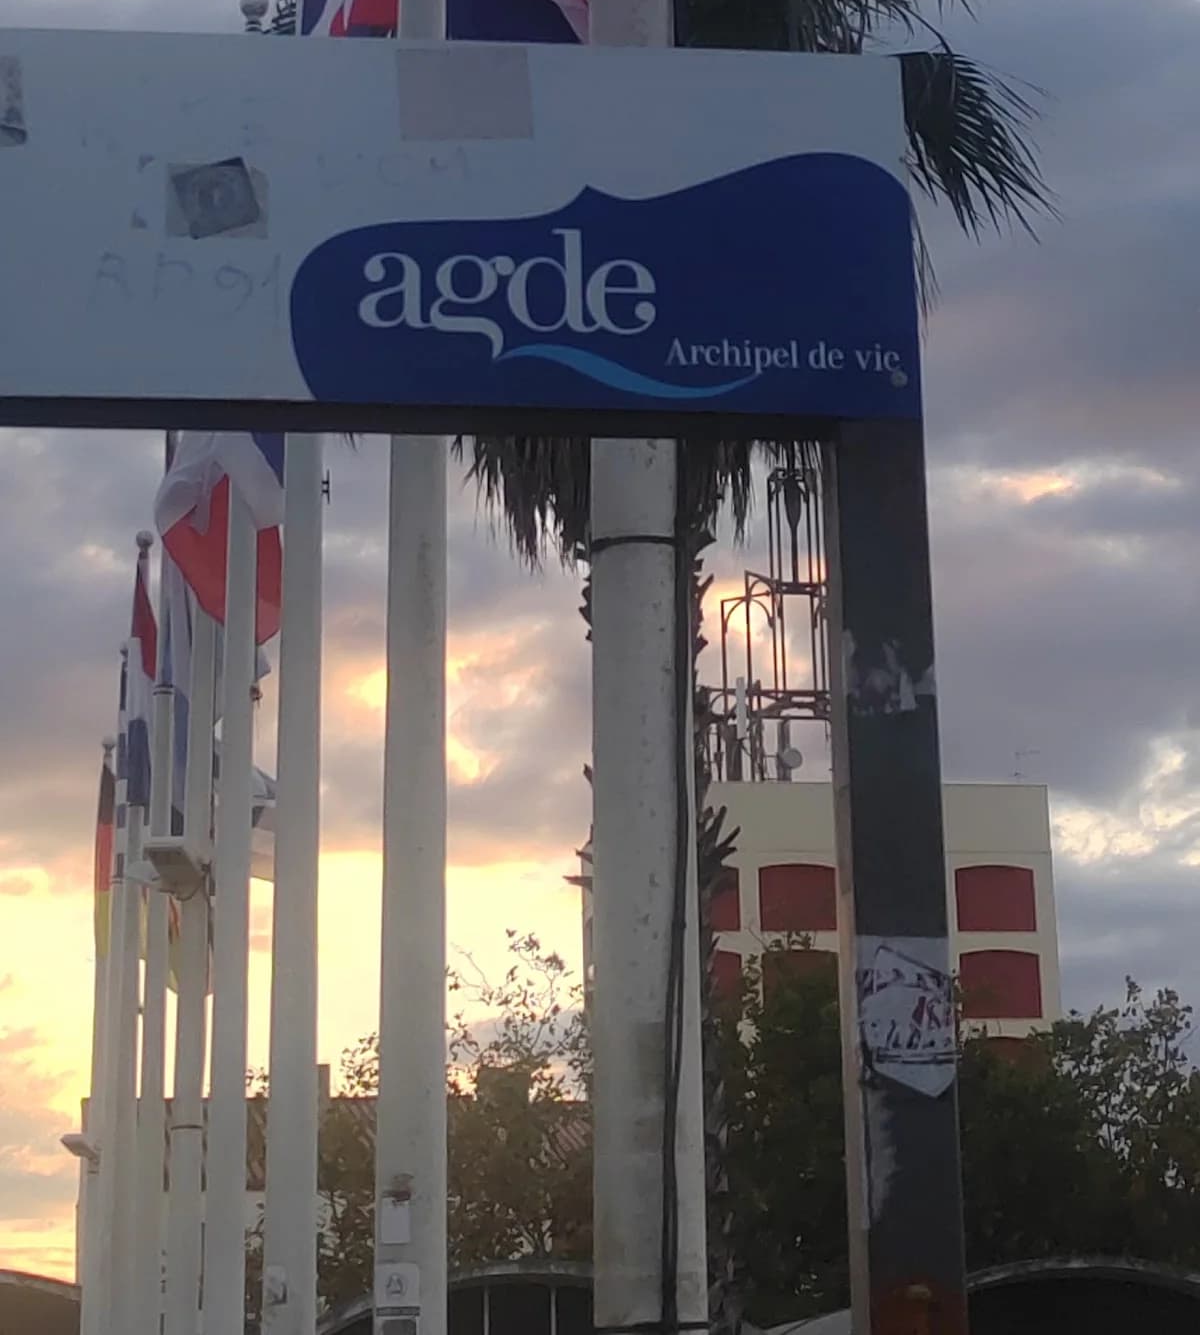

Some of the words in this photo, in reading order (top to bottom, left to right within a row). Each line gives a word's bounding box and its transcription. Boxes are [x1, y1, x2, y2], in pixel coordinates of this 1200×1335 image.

[358, 229, 656, 359] agde
[667, 337, 799, 374] Archipel
[808, 341, 845, 370] de
[855, 343, 900, 373] vie
